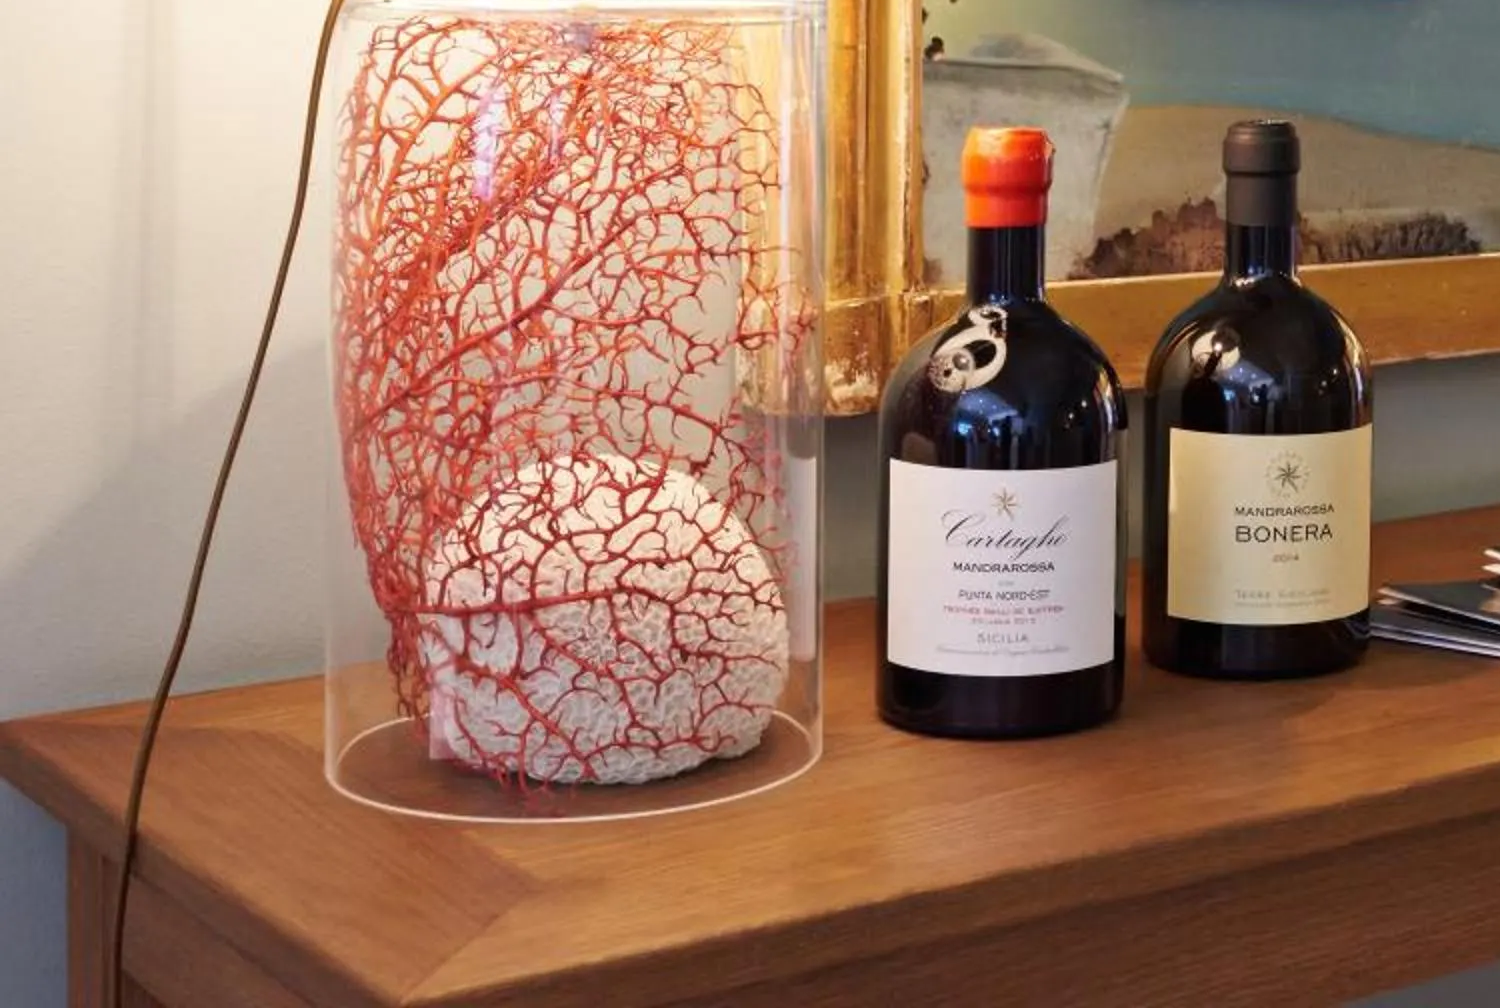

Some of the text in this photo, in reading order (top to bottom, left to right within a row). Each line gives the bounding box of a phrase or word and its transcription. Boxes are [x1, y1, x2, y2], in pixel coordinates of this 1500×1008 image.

[1234, 503, 1335, 517] MANDRAROSSA
[1234, 523, 1334, 543] BONERA
[953, 561, 1055, 573] MANDRAROSSA
[958, 589, 992, 600] PUNTA
[977, 633, 1029, 644] SICILIA
